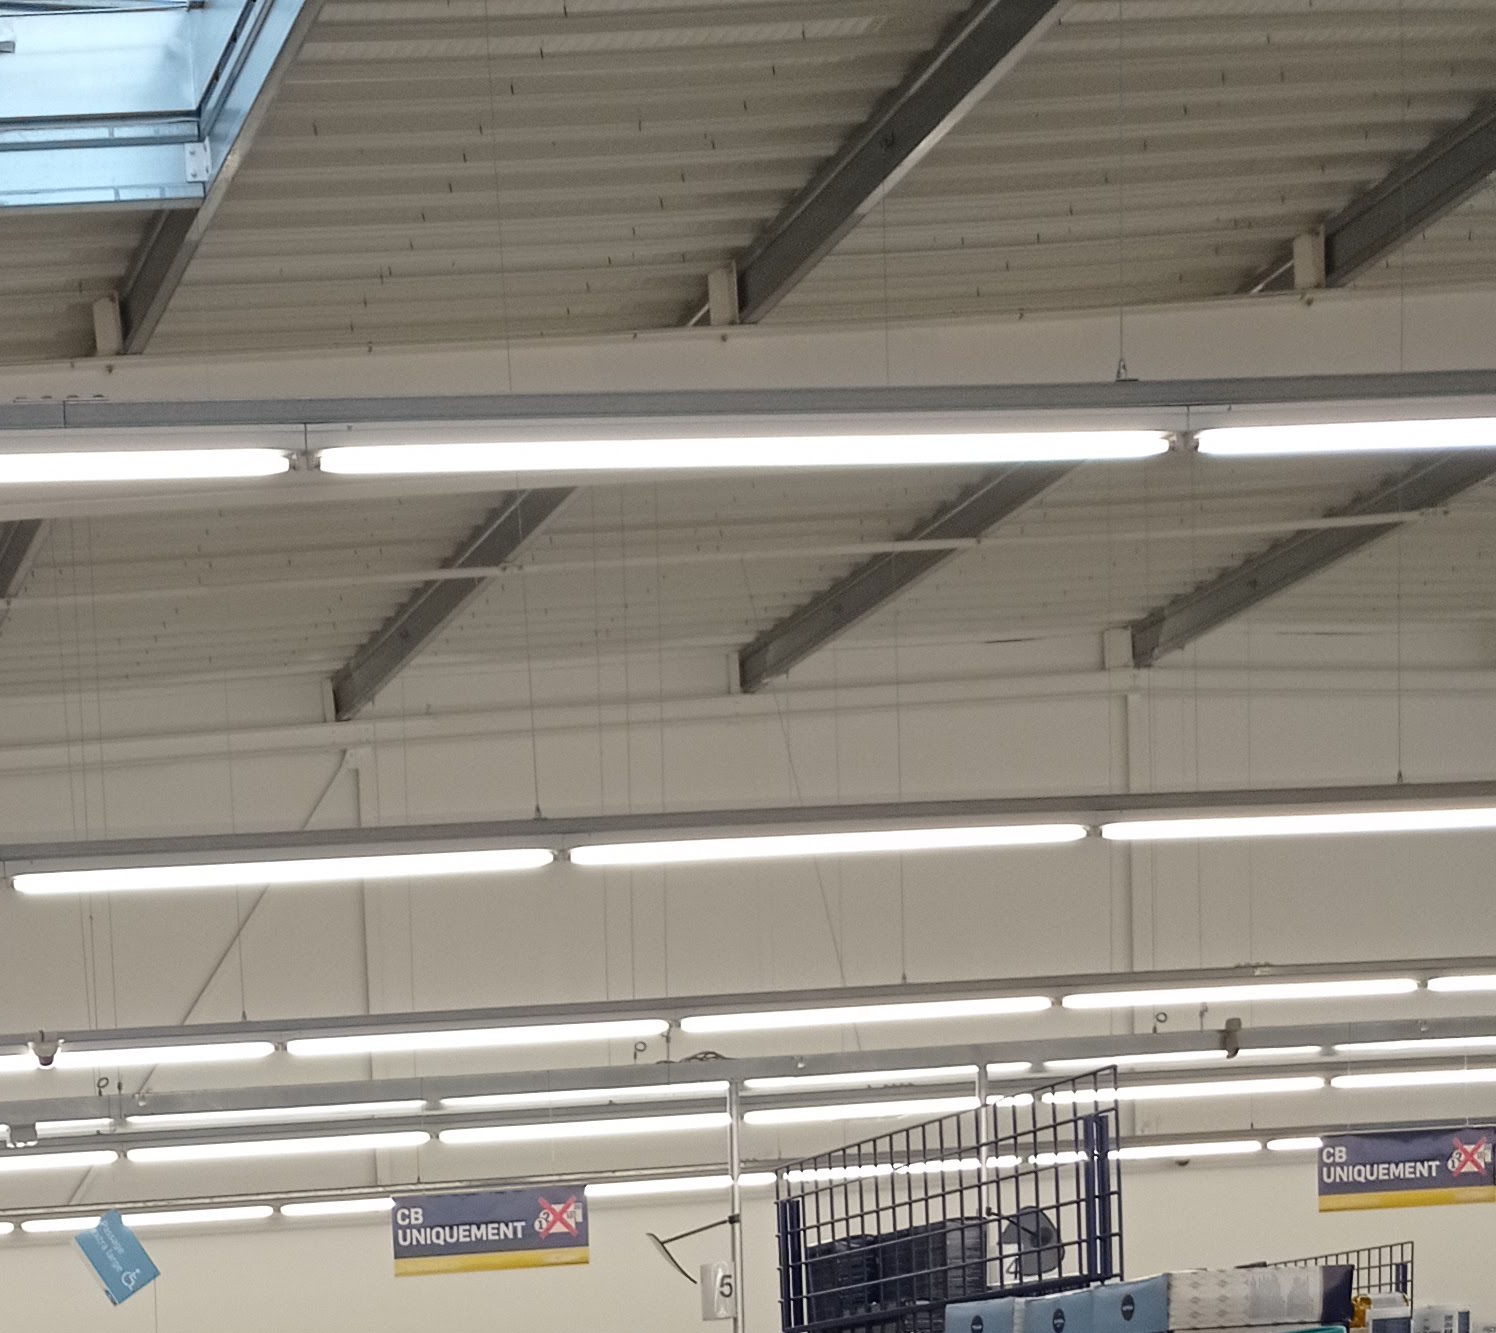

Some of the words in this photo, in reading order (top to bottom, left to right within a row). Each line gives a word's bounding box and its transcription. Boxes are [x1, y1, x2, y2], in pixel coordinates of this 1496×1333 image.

[1322, 1147, 1347, 1163] CB
[1322, 1161, 1441, 1184] UNIQUEMENT
[397, 1208, 424, 1226] CB
[398, 1221, 526, 1245] UNIQUEMENT
[719, 1274, 733, 1298] 5
